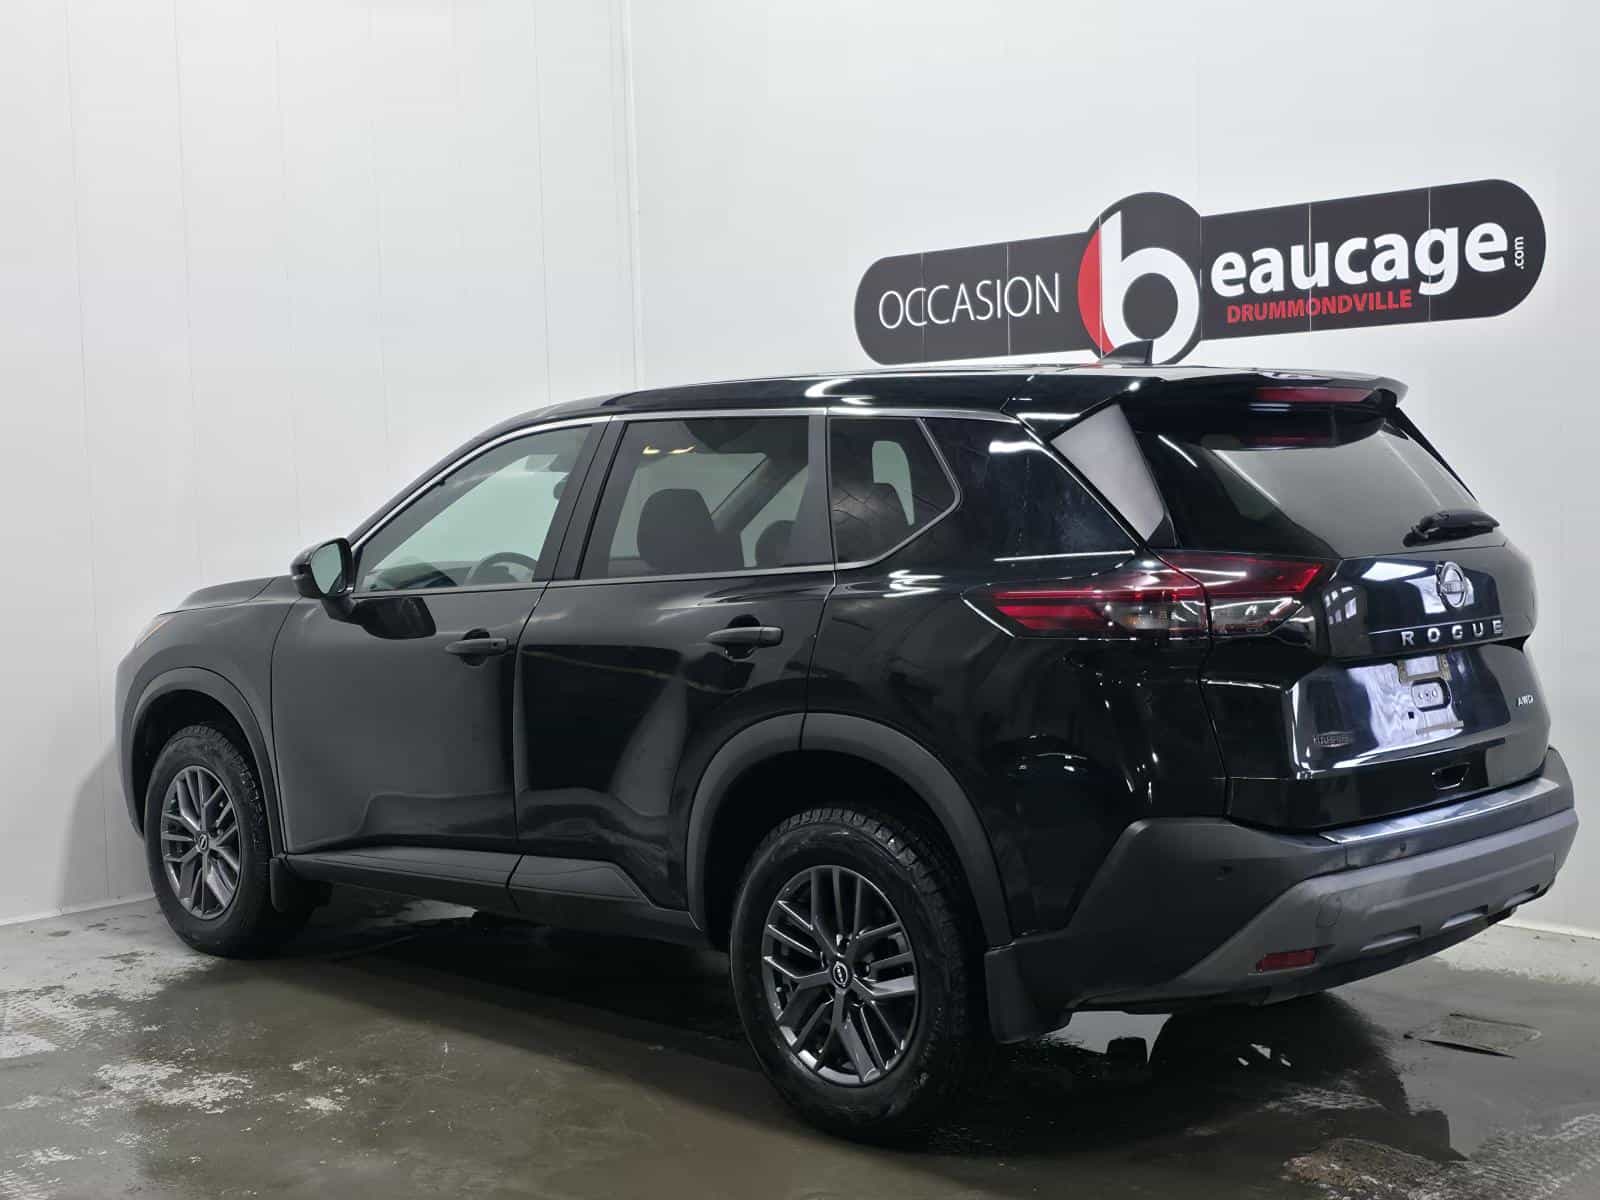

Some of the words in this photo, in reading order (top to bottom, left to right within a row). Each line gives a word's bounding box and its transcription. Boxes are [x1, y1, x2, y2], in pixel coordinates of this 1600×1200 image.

[878, 272, 1060, 329] OCCASION
[1226, 289, 1413, 324] DRUMMONDVILLE
[1400, 619, 1504, 648] ROGUE
